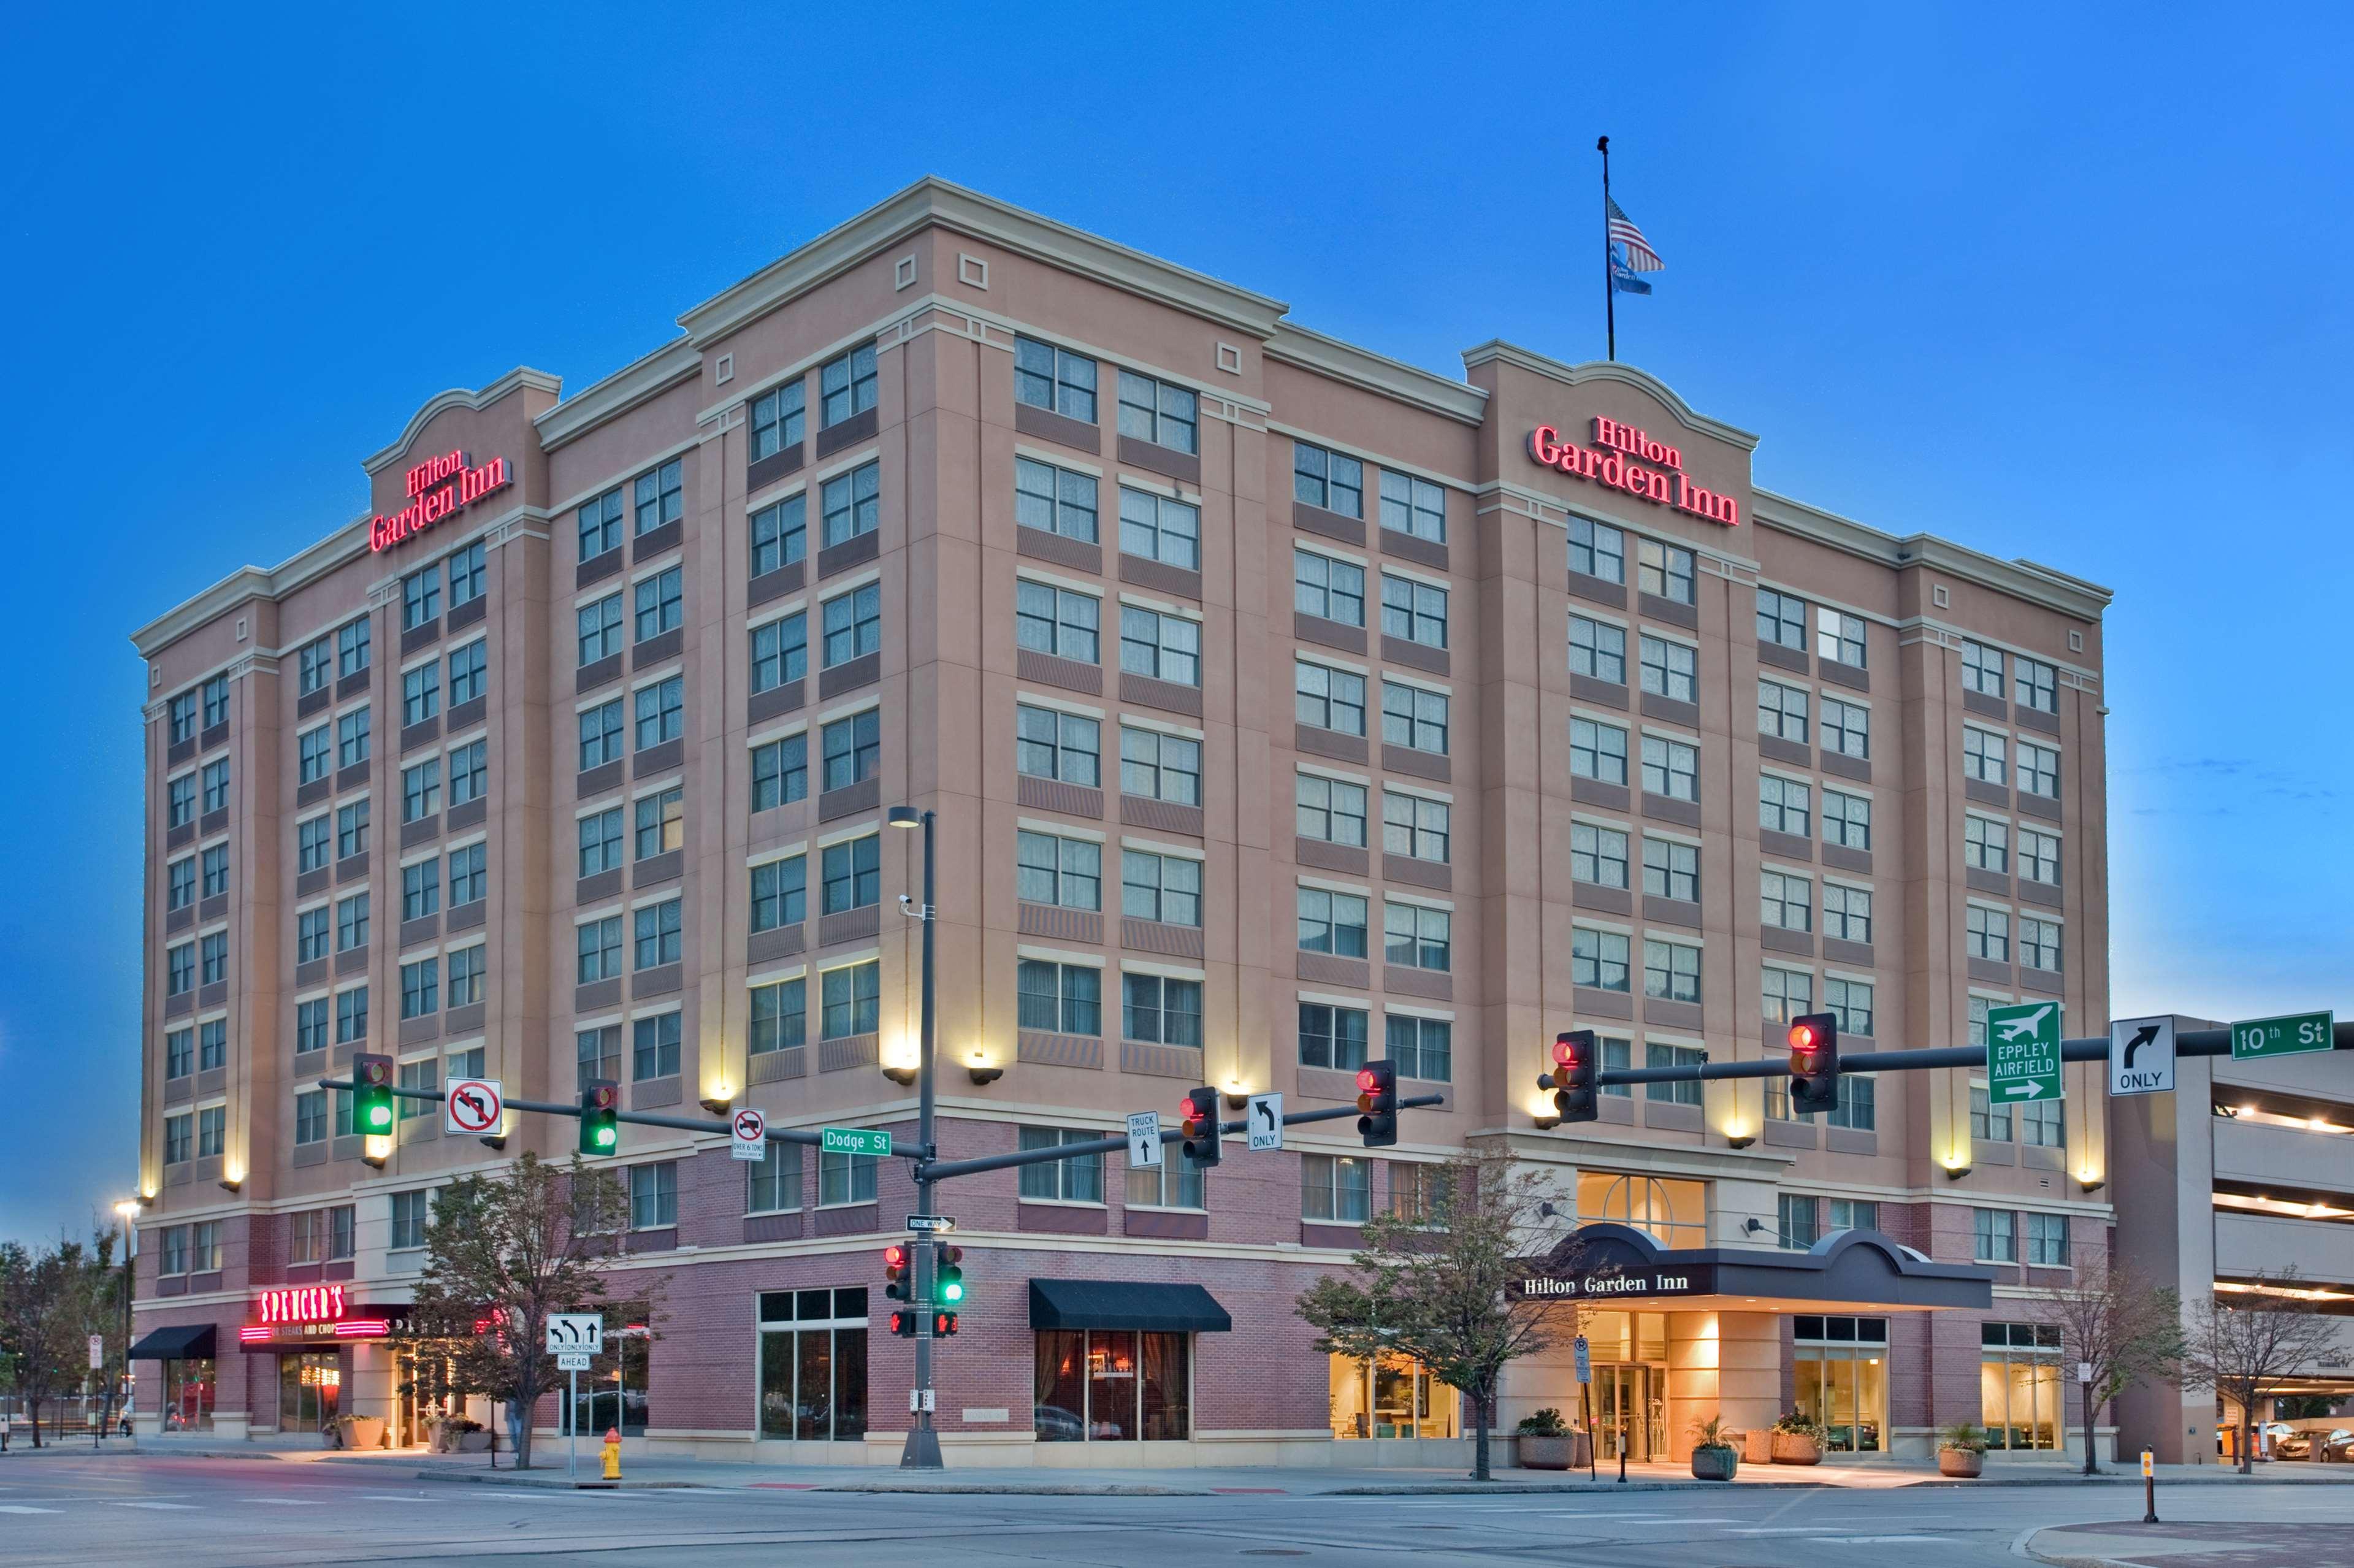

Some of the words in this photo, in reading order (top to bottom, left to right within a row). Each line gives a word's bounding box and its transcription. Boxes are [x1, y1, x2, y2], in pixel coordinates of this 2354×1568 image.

[1595, 415, 1682, 470] Hilton
[407, 449, 463, 498] Hilton
[1534, 426, 1670, 503] Garden
[1677, 472, 1739, 526] Inn
[370, 485, 455, 552] Garden
[460, 457, 505, 505] Inn
[2240, 1026, 2280, 1050] 10th
[2298, 1022, 2324, 1044] St
[1998, 1042, 2049, 1060] EPPLEY
[1995, 1058, 2054, 1077] AIRFIELD
[2120, 1073, 2162, 1088] ONLY
[1131, 1116, 1153, 1126] TRUCK
[827, 1131, 865, 1152] Dodge
[874, 1135, 887, 1150] St
[1132, 1126, 1155, 1137] ROUTE
[1253, 1134, 1275, 1147] ONLY
[1524, 1277, 1575, 1295] Hilton
[1584, 1274, 1647, 1293] Garden
[1656, 1274, 1688, 1290] Inn
[261, 1285, 343, 1323] SPENCER'S
[281, 1325, 303, 1336] STEAKS
[304, 1325, 317, 1335] AND
[560, 1358, 587, 1366] AHEAD
